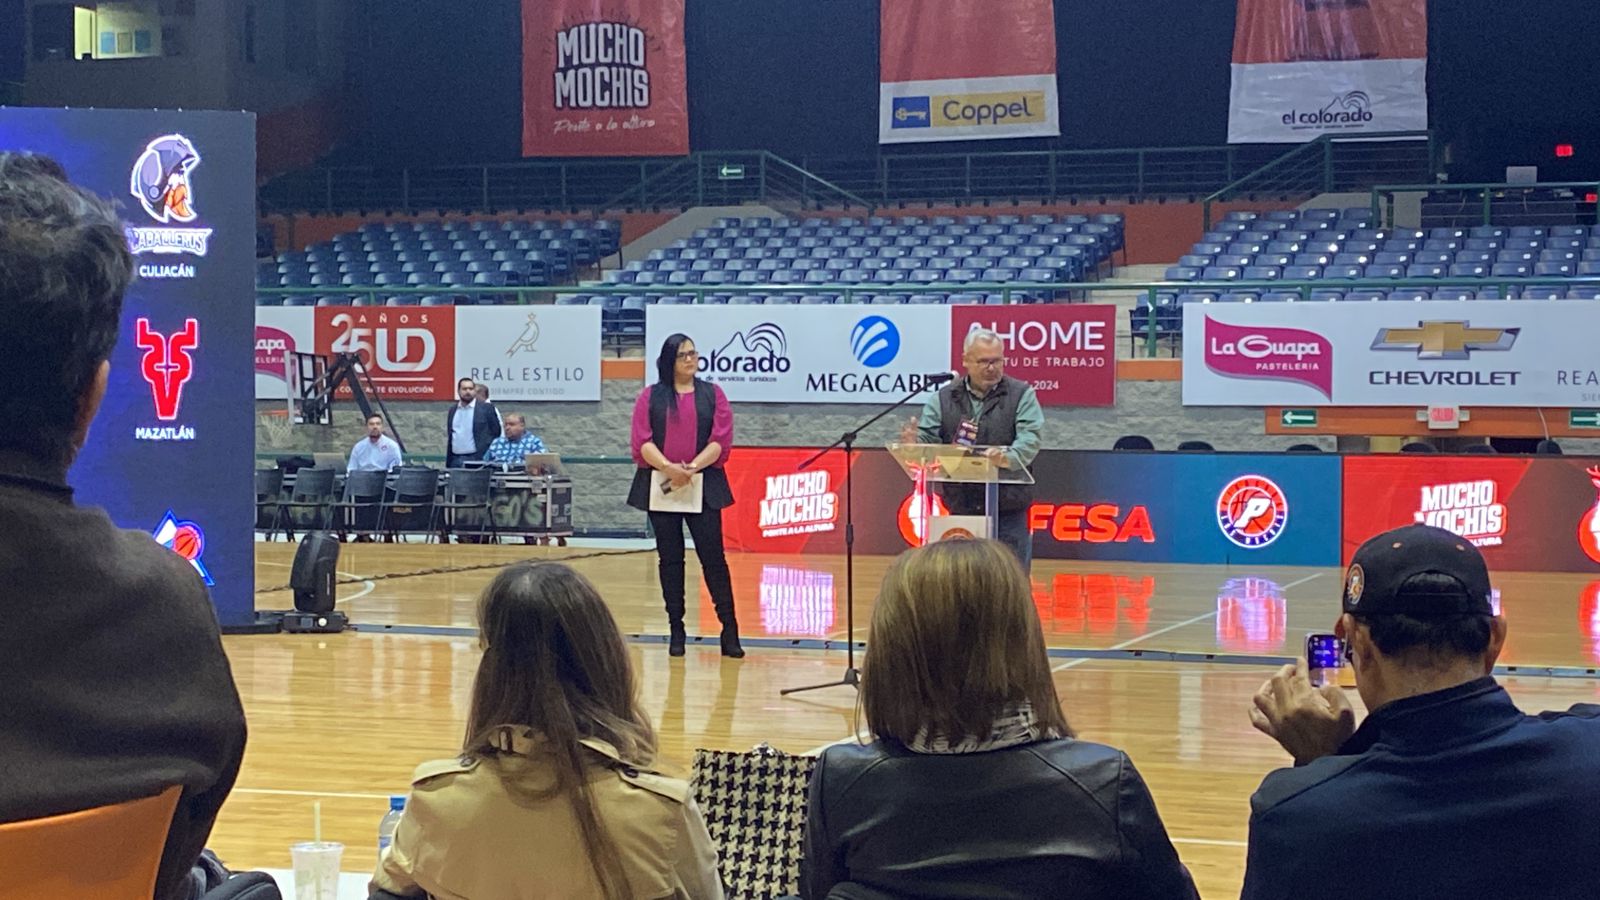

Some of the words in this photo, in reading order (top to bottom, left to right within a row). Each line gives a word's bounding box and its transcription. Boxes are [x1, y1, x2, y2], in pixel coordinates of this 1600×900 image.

[557, 22, 645, 69] MUCHO
[555, 66, 649, 108] MOCHIS
[943, 96, 1035, 125] Coppel
[1281, 110, 1297, 125] el
[1299, 107, 1373, 124] colorado
[126, 228, 211, 252] CABALLEROS
[139, 263, 195, 278] CULIACÁN
[360, 314, 429, 324] AÑOS
[1211, 337, 1236, 355] La
[1237, 334, 1322, 361] Guapa
[697, 349, 791, 373] olorado
[1023, 357, 1040, 367] DE
[1046, 357, 1105, 367] TRABAJO
[471, 367, 515, 381] REAL
[523, 367, 585, 381] ESTILO
[806, 373, 940, 393] MEGACABL
[1369, 371, 1521, 386] CHEVROLET
[135, 425, 195, 440] MAZATLÁN
[764, 469, 830, 501] MUCHO
[1420, 480, 1497, 513] MUCHO
[758, 492, 838, 527] MOCHIS
[1029, 504, 1155, 542] FESA
